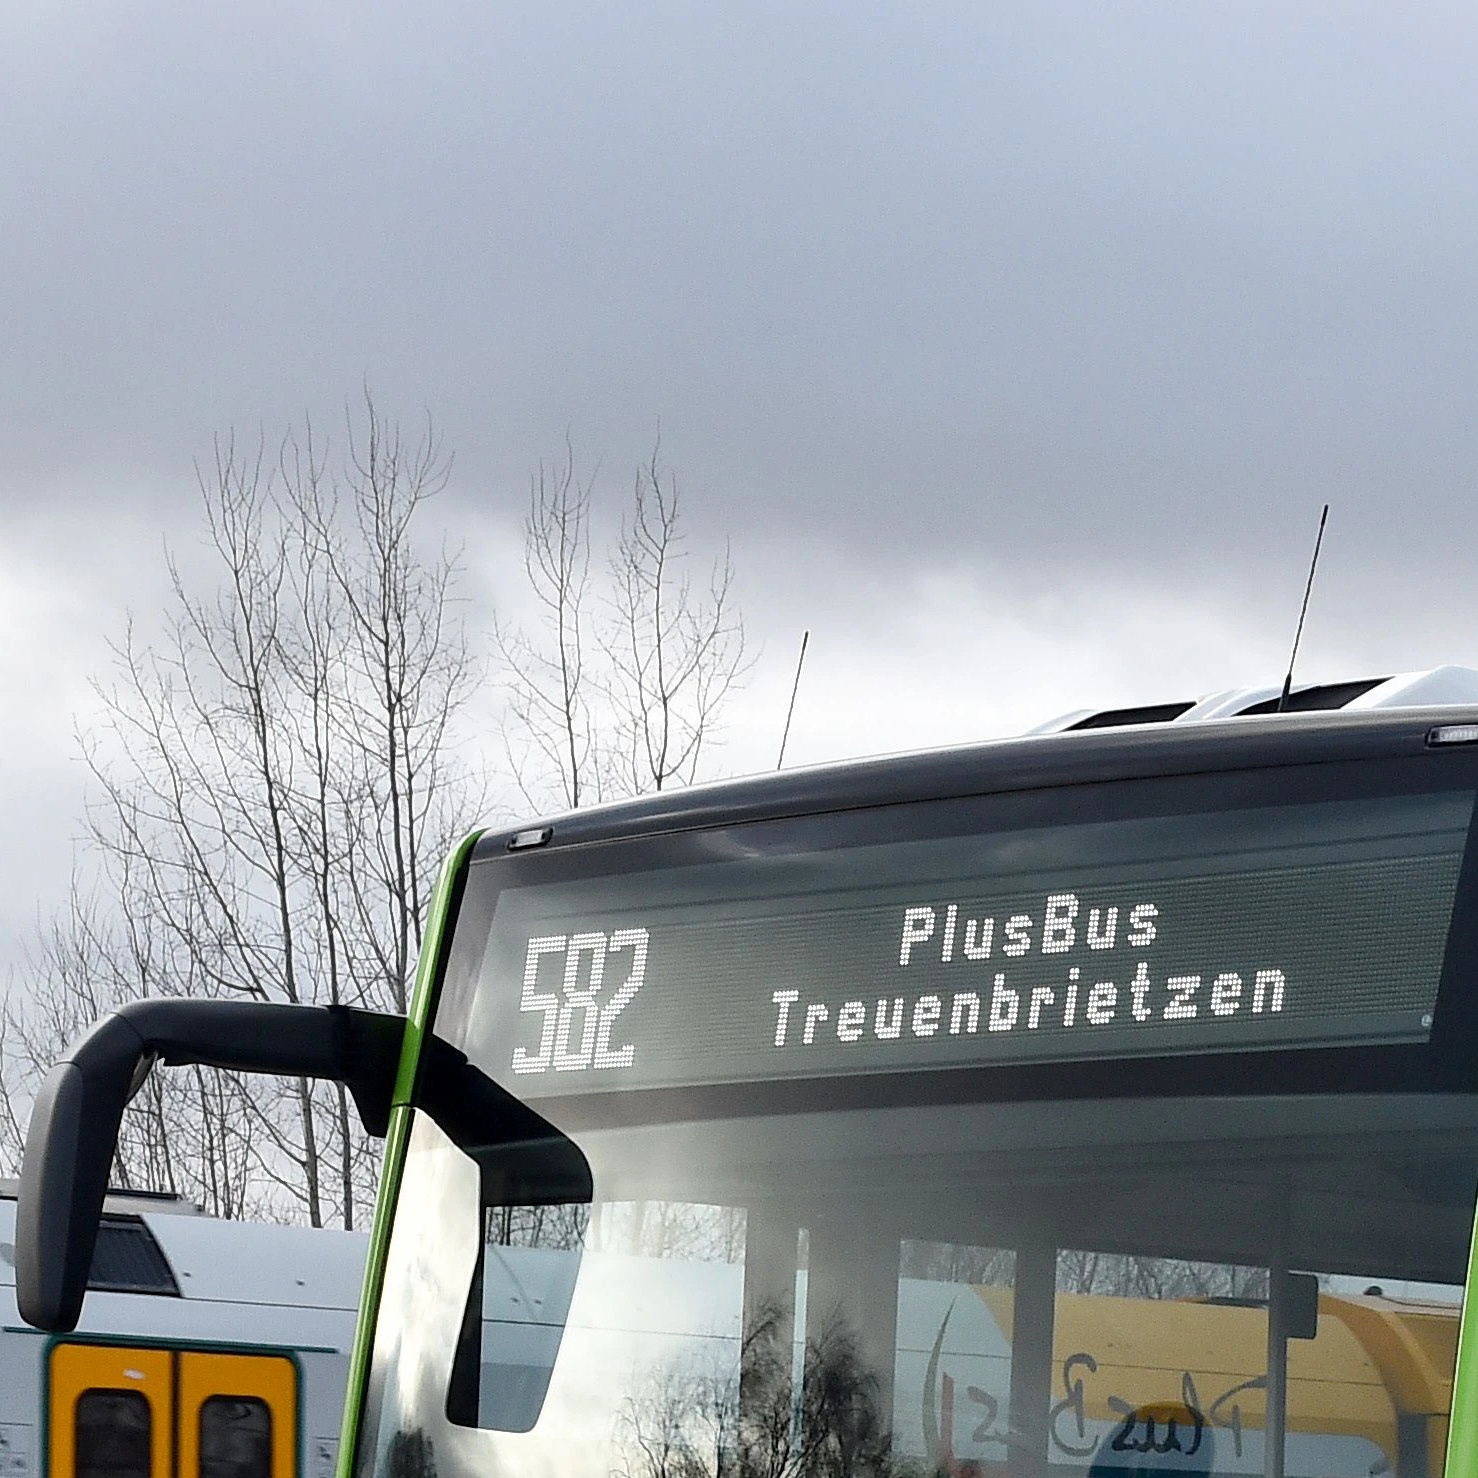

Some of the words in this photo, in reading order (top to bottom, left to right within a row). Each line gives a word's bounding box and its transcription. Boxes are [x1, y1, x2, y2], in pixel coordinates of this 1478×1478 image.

[898, 893, 1162, 966] PlusBus
[512, 928, 649, 1074] 582
[770, 961, 1286, 1047] Treuenbrietzen
